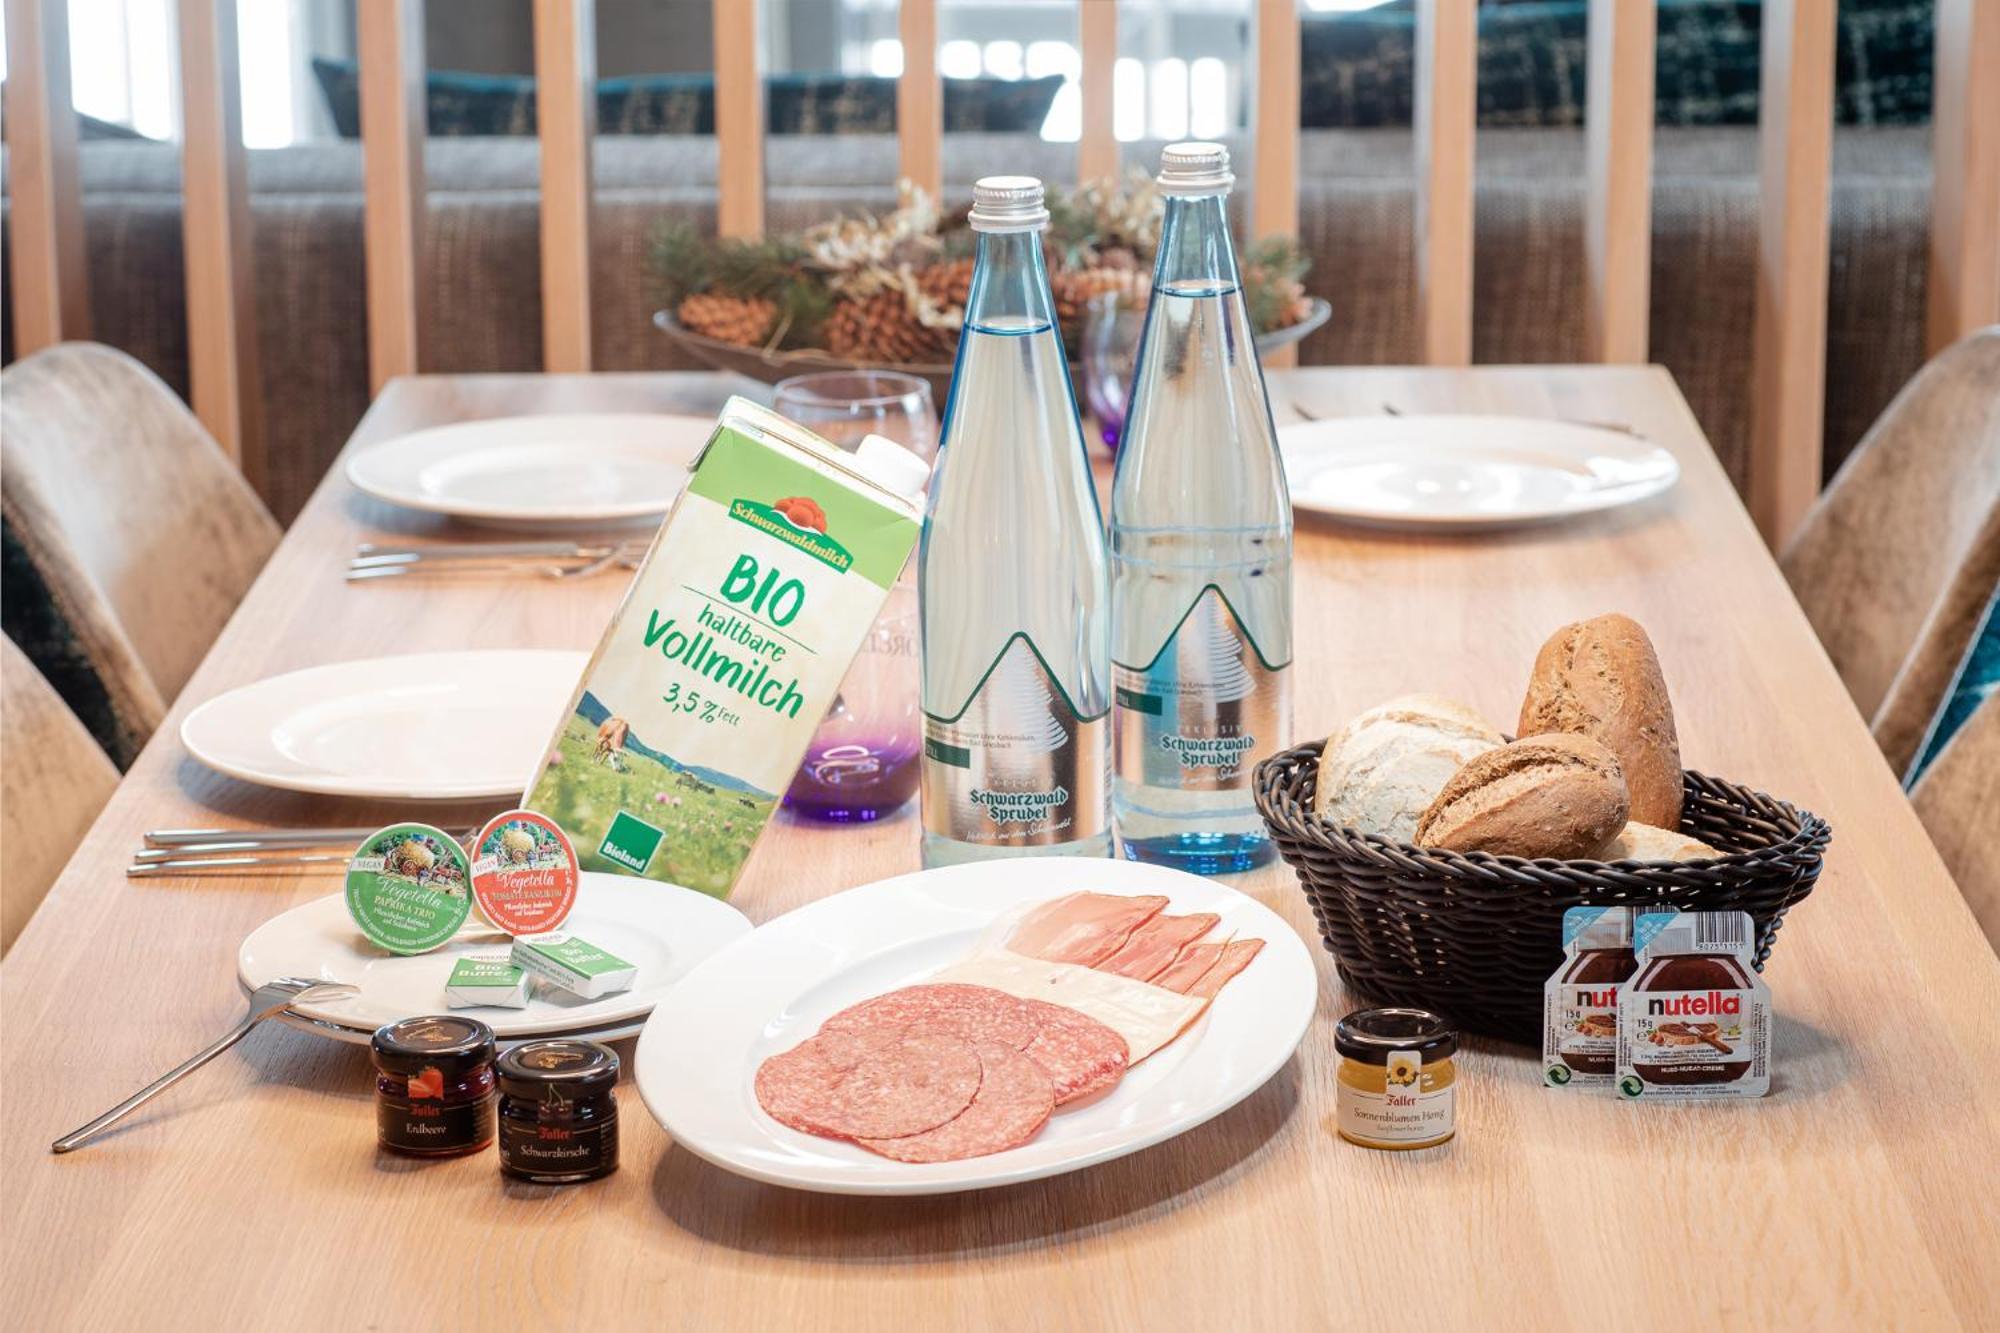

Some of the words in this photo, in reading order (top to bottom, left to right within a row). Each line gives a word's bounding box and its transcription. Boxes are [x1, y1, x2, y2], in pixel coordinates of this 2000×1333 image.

[732, 501, 850, 570] Schwarzwaldmilch
[720, 553, 806, 628] BIO
[697, 603, 787, 663] haltbare
[643, 608, 805, 720] Vollmilch
[717, 707, 742, 727] Fett
[1161, 735, 1256, 752] Schwarzwald
[1181, 751, 1237, 768] Sprudel
[969, 787, 1068, 807] Schwarzwald
[989, 805, 1048, 823] Sprudel
[602, 840, 646, 870] Bioland
[376, 876, 442, 908] Vegetella
[374, 895, 412, 913] PAPRIKA
[413, 906, 436, 920] TRIO
[1648, 991, 1740, 1016] nutella
[1386, 1093, 1417, 1107] Faller
[405, 1122, 447, 1135] Erdbeere
[519, 1144, 590, 1159] Schwarzkirsche
